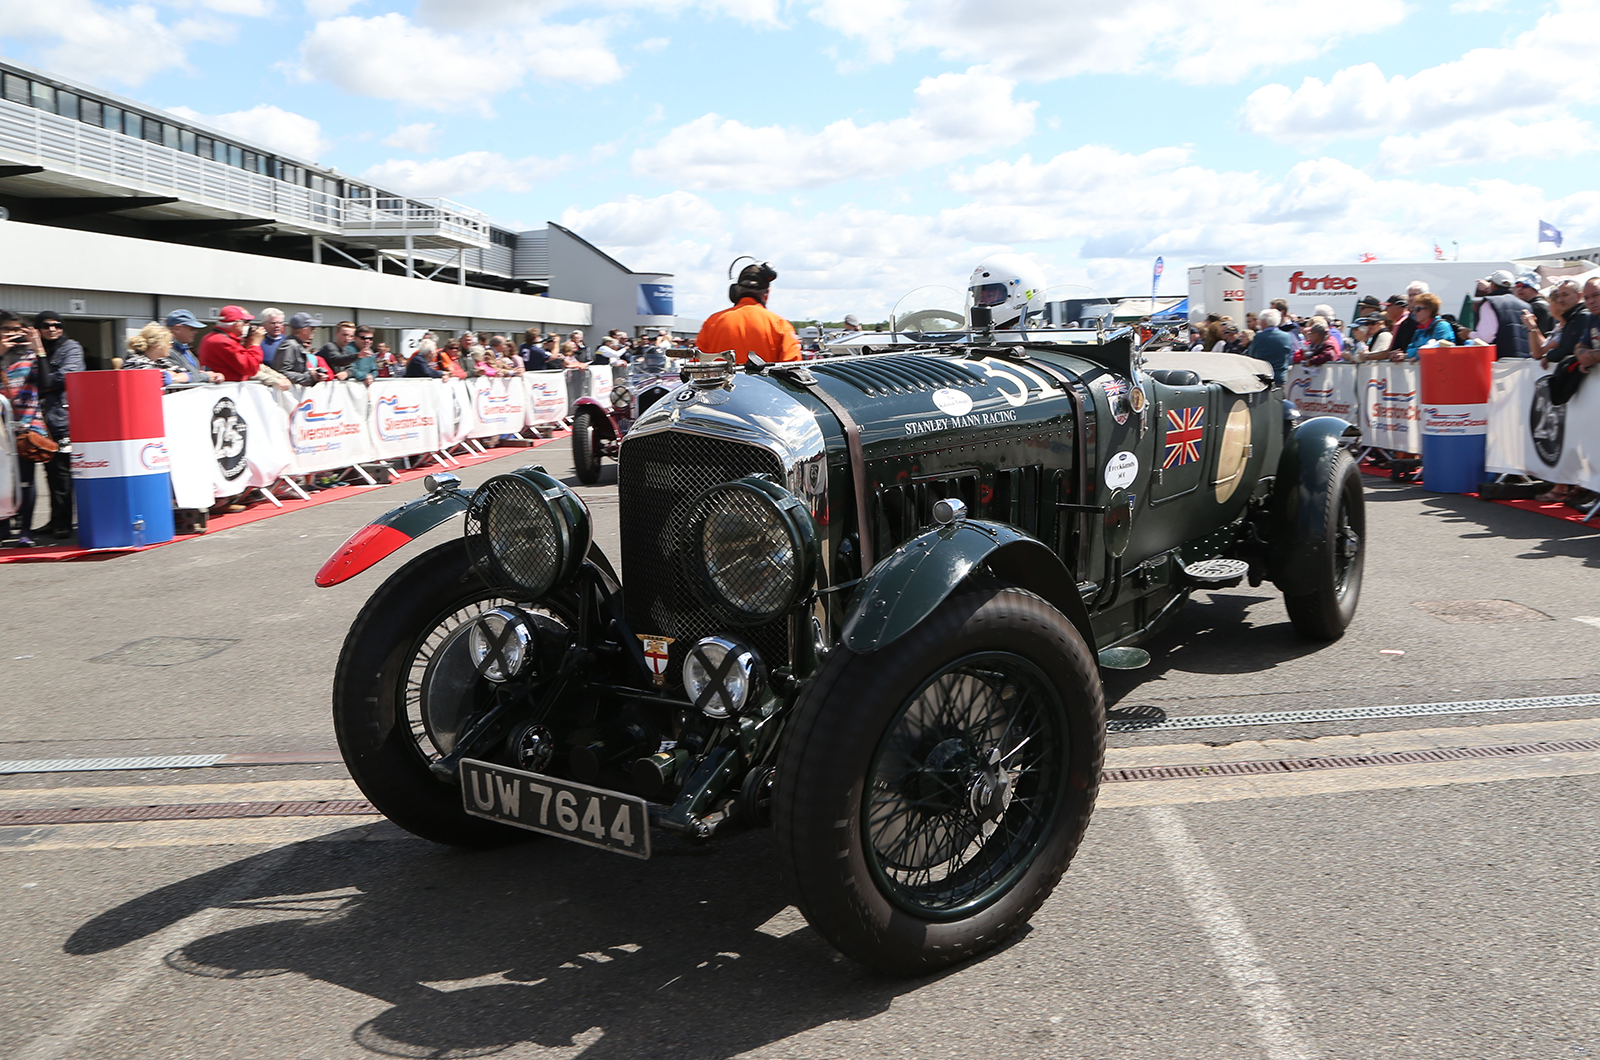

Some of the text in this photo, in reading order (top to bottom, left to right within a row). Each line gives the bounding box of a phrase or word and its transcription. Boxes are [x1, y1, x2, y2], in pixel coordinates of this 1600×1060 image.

[1289, 271, 1358, 294] fortec
[905, 410, 1017, 435] STANLEY MANN RACING
[471, 770, 635, 847] UW 7644
